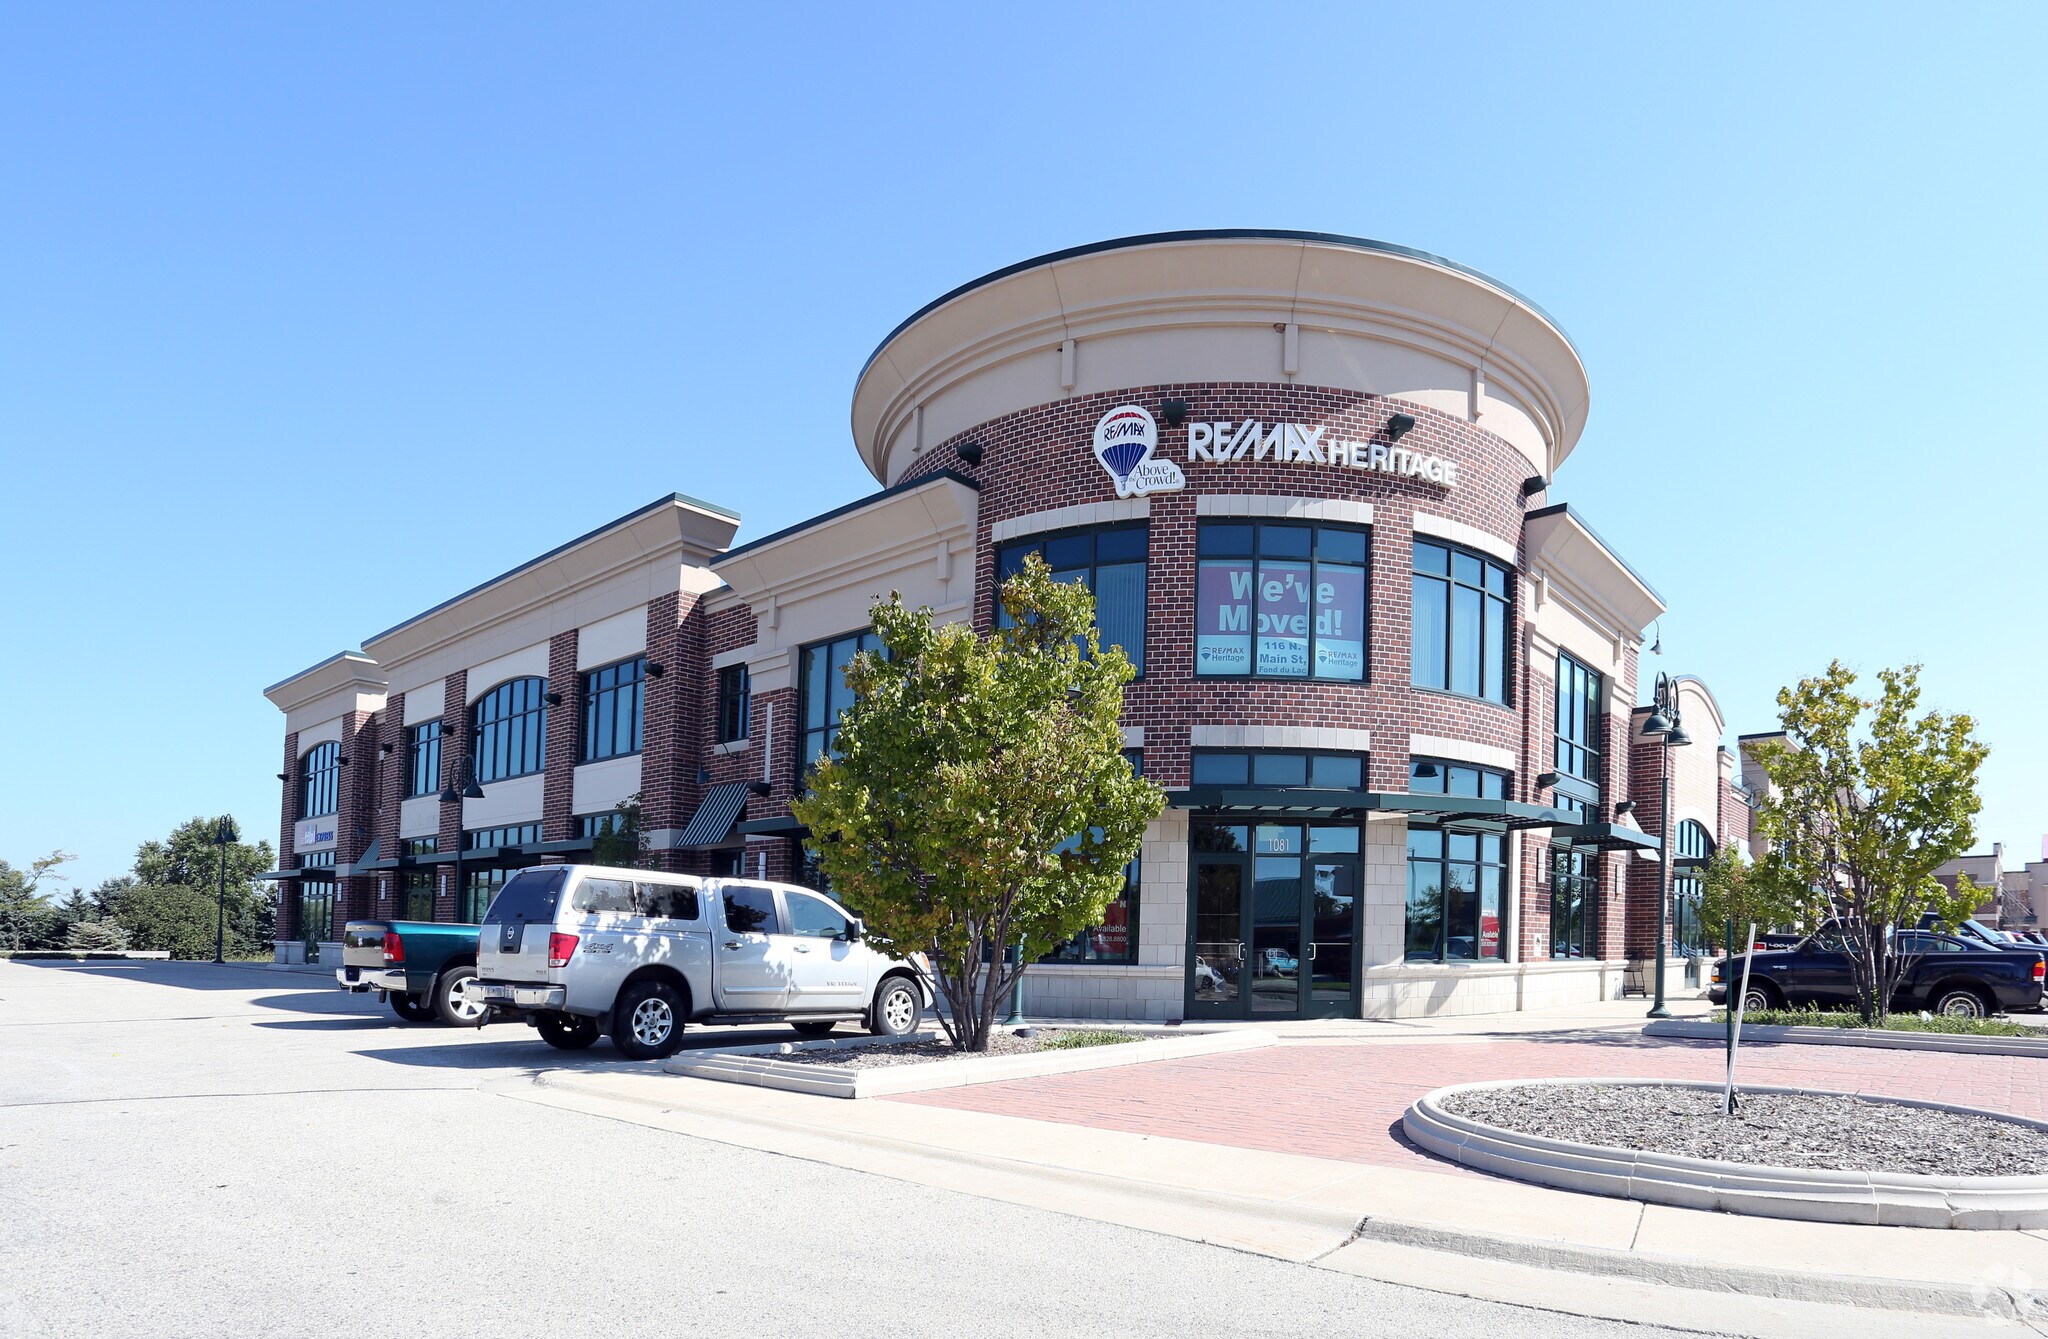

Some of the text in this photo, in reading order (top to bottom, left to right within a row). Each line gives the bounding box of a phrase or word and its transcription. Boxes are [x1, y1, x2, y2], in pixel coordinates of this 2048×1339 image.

[1104, 422, 1146, 442] RE/MAX
[1188, 418, 1458, 488] RE/MAX HERITAGE
[1134, 464, 1169, 477] Above
[1229, 571, 1335, 604] We've
[1219, 604, 1343, 636] Moved!
[1211, 647, 1245, 655] RE/MAX
[1264, 641, 1301, 651] 116 N.
[1211, 654, 1245, 662] Heritage
[1259, 653, 1288, 664] Main
[1328, 651, 1358, 660] RE/MAX
[1328, 658, 1358, 667] Heritage
[1258, 665, 1307, 674] Fond du Lac
[1268, 838, 1290, 852] 1081
[1092, 924, 1127, 933] Available
